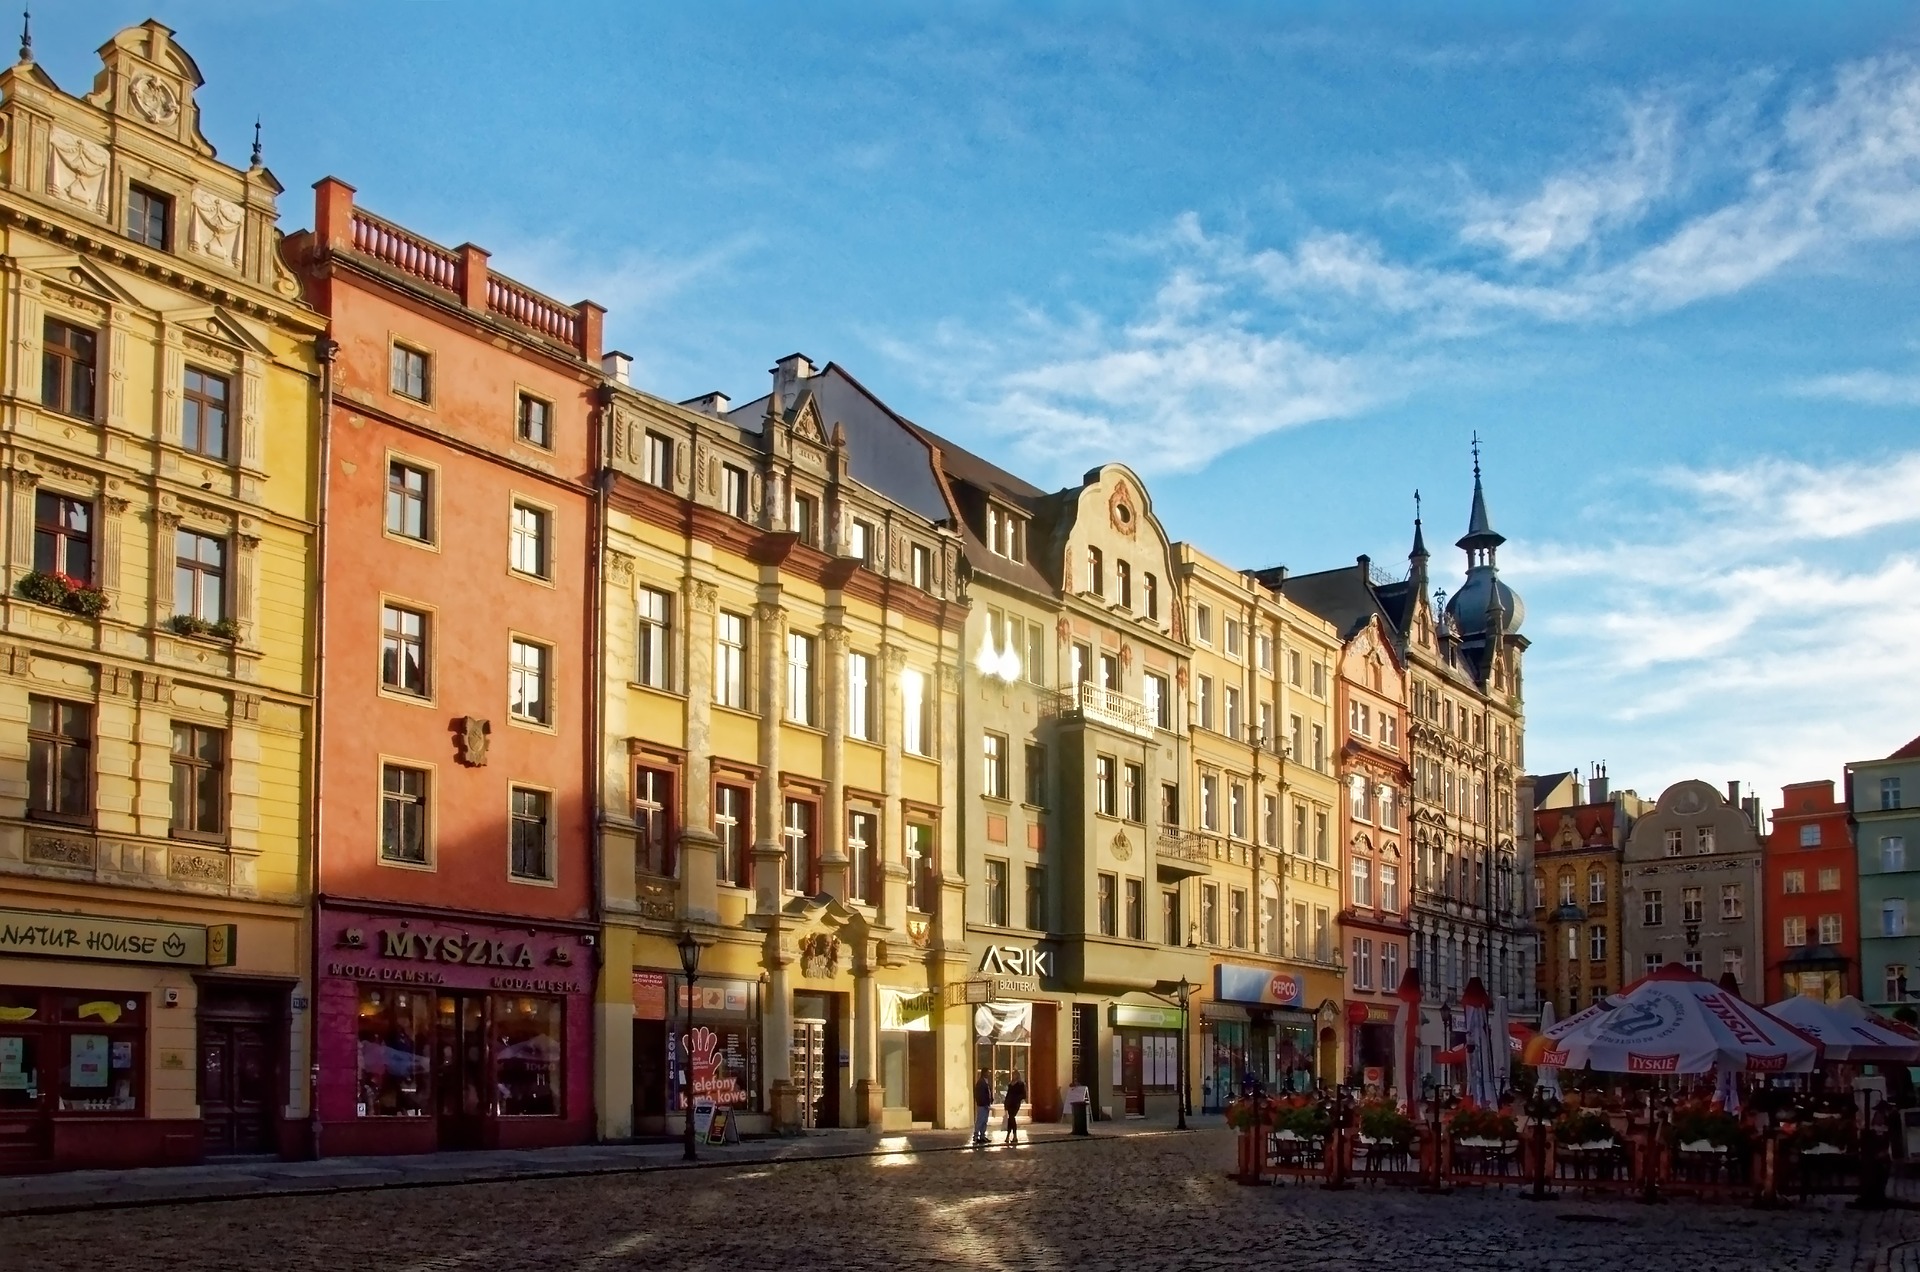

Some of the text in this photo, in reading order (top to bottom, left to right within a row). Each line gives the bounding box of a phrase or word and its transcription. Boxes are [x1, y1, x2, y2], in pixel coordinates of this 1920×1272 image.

[1, 924, 157, 953] NATUR HOUSE
[384, 930, 534, 969] MYSZKA
[332, 963, 445, 984] MODA DAMSKA
[493, 977, 532, 991] MODA
[999, 979, 1037, 992] BIŻUTERIA
[1272, 980, 1296, 996] PEPCO
[1547, 1008, 1600, 1036] TYSKIE
[1695, 994, 1762, 1045] TYSKIE
[668, 1032, 676, 1080] KOMIS
[1543, 1051, 1567, 1065] TYSKIE
[1631, 1055, 1675, 1070] TYSKIE
[1749, 1056, 1785, 1070] TYSKIE
